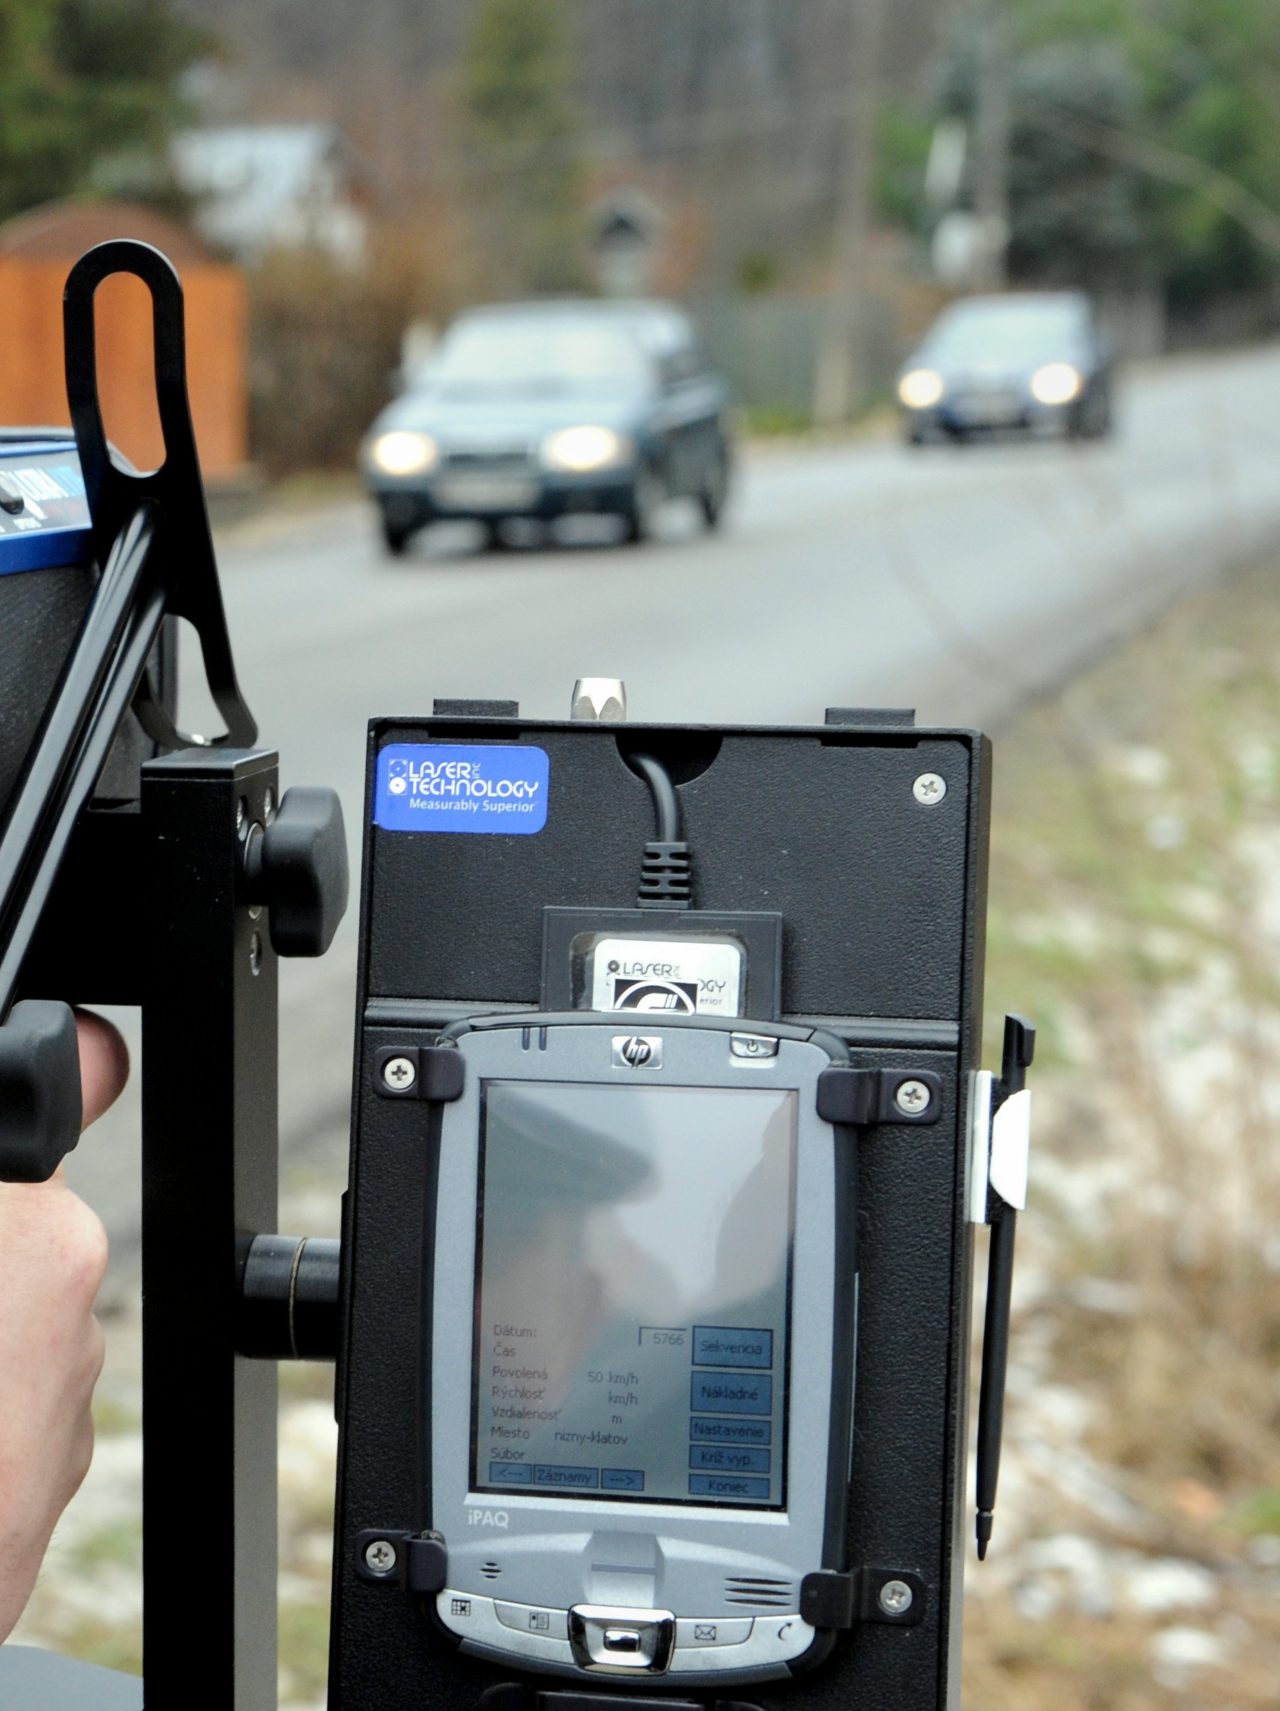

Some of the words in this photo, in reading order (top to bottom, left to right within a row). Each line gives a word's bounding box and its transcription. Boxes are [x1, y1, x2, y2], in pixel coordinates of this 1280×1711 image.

[408, 761, 472, 779] LASER
[409, 777, 539, 798] TECHNOLOGY
[409, 798, 480, 813] Measurably
[482, 799, 535, 814] Superior
[623, 961, 673, 977] LASER
[625, 1036, 650, 1068] hp
[492, 1341, 516, 1357] Čas
[701, 1340, 763, 1355] Sekvencia
[492, 1365, 548, 1380] Povolená
[587, 1371, 604, 1383] 50
[608, 1371, 639, 1386] km/h
[608, 1391, 639, 1406] km/h
[701, 1385, 760, 1401] Nákladné
[611, 1414, 623, 1424] m
[490, 1425, 530, 1440] Miesto
[694, 1422, 764, 1438] Nastavenie
[708, 1480, 749, 1494] Koniec
[468, 1509, 509, 1529] iPAQ
